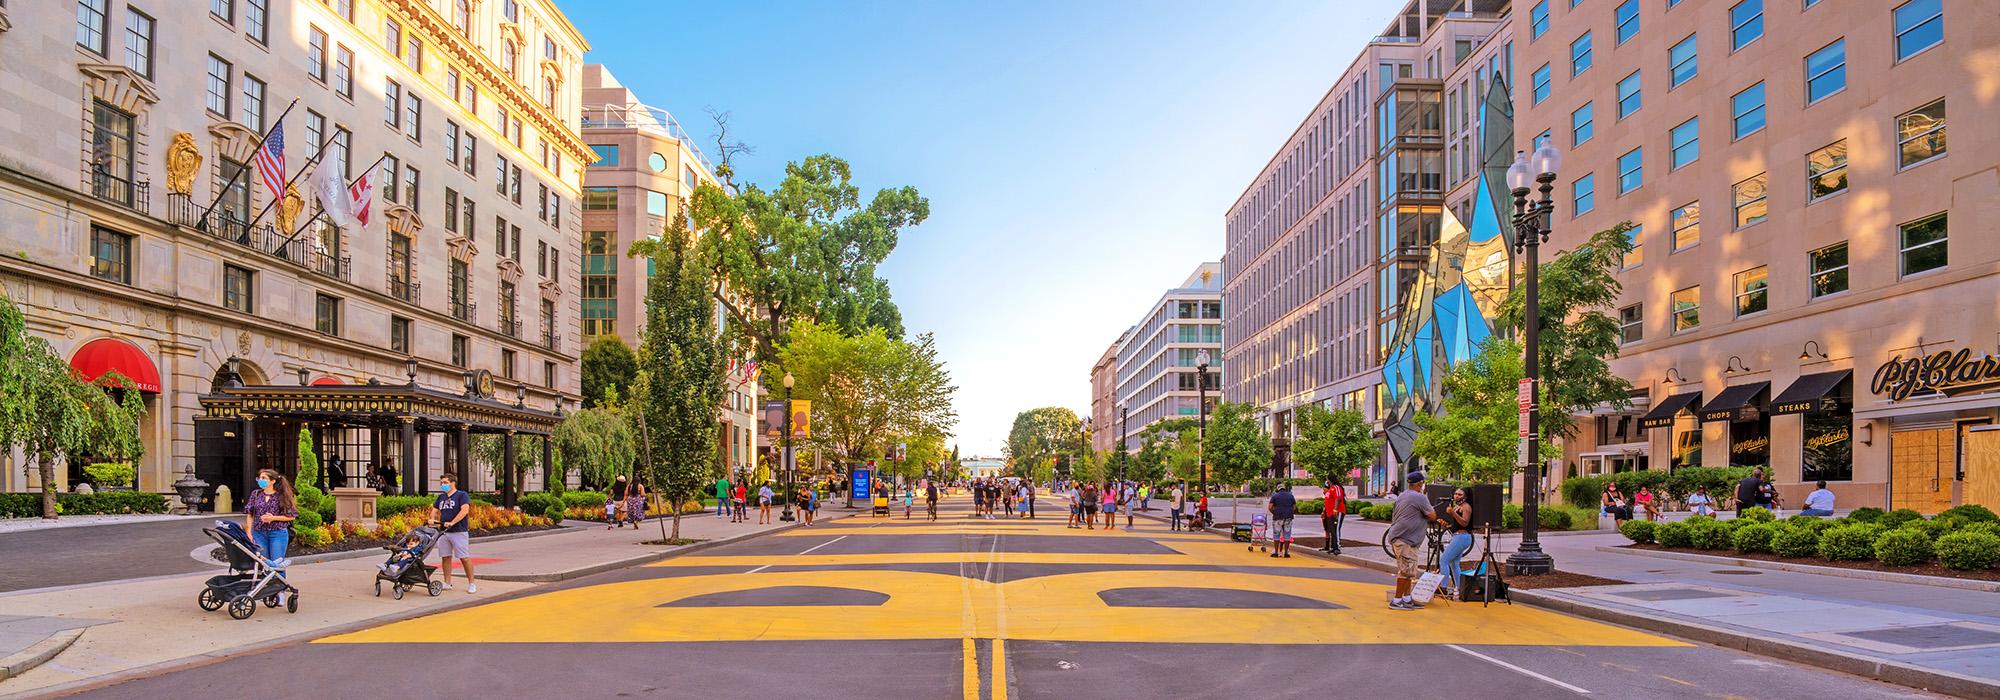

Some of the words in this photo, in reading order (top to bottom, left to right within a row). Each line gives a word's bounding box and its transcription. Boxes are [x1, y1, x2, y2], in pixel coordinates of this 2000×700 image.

[137, 382, 158, 391] REGIS
[1778, 402, 1811, 412] STEAKS
[1706, 411, 1731, 420] CHOPS
